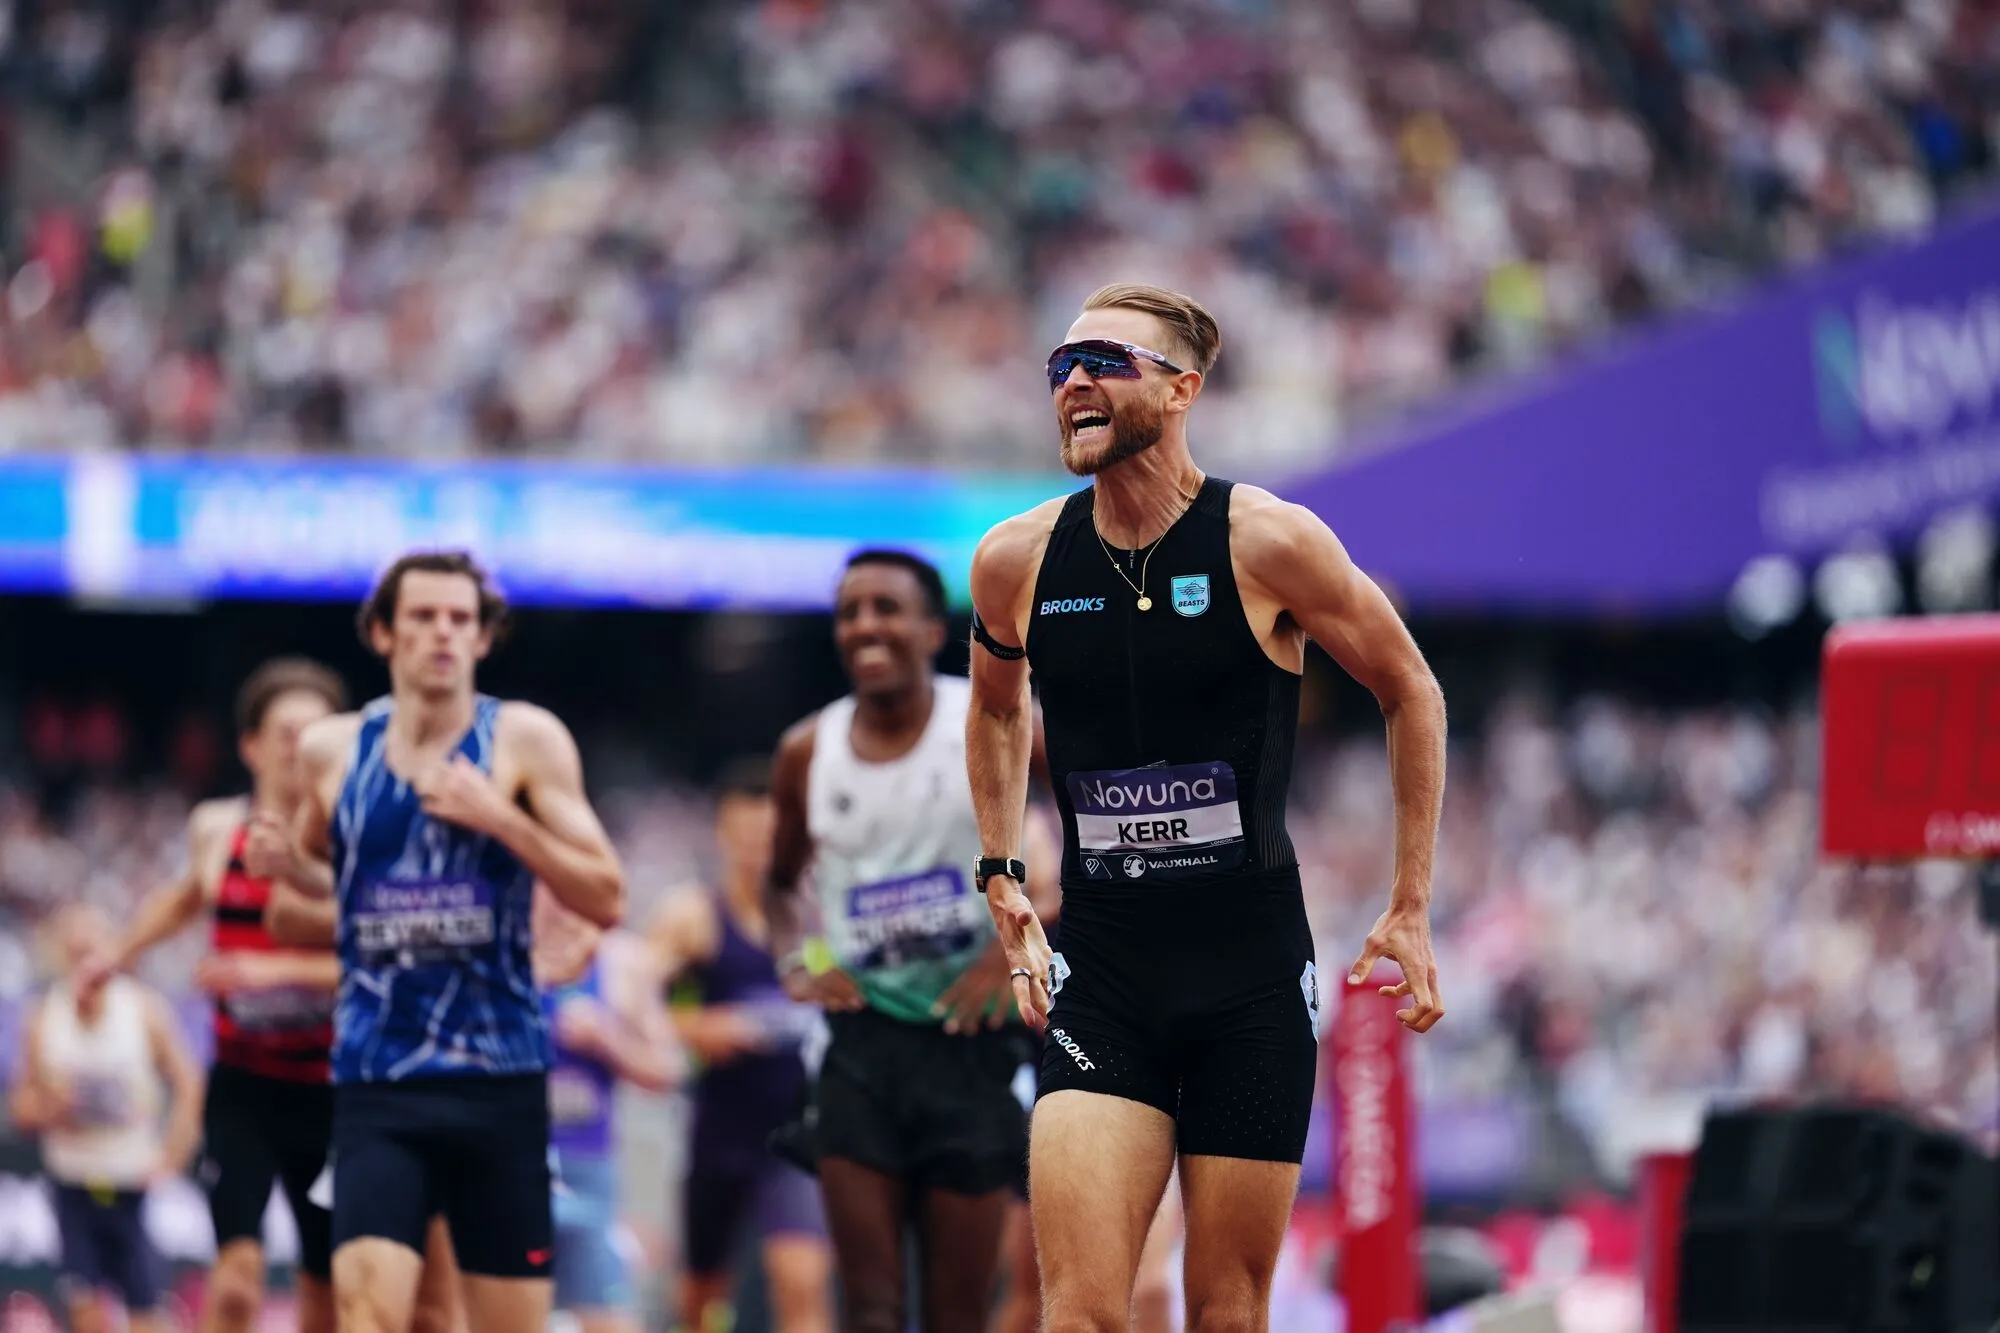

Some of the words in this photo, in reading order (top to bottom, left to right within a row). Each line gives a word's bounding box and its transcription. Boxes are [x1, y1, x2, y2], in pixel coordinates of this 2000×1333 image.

[1040, 597, 1106, 615] BROOKS
[1178, 599, 1205, 608] BEASTS
[1118, 818, 1190, 844] KERR
[1148, 855, 1219, 869] VAUXHALL
